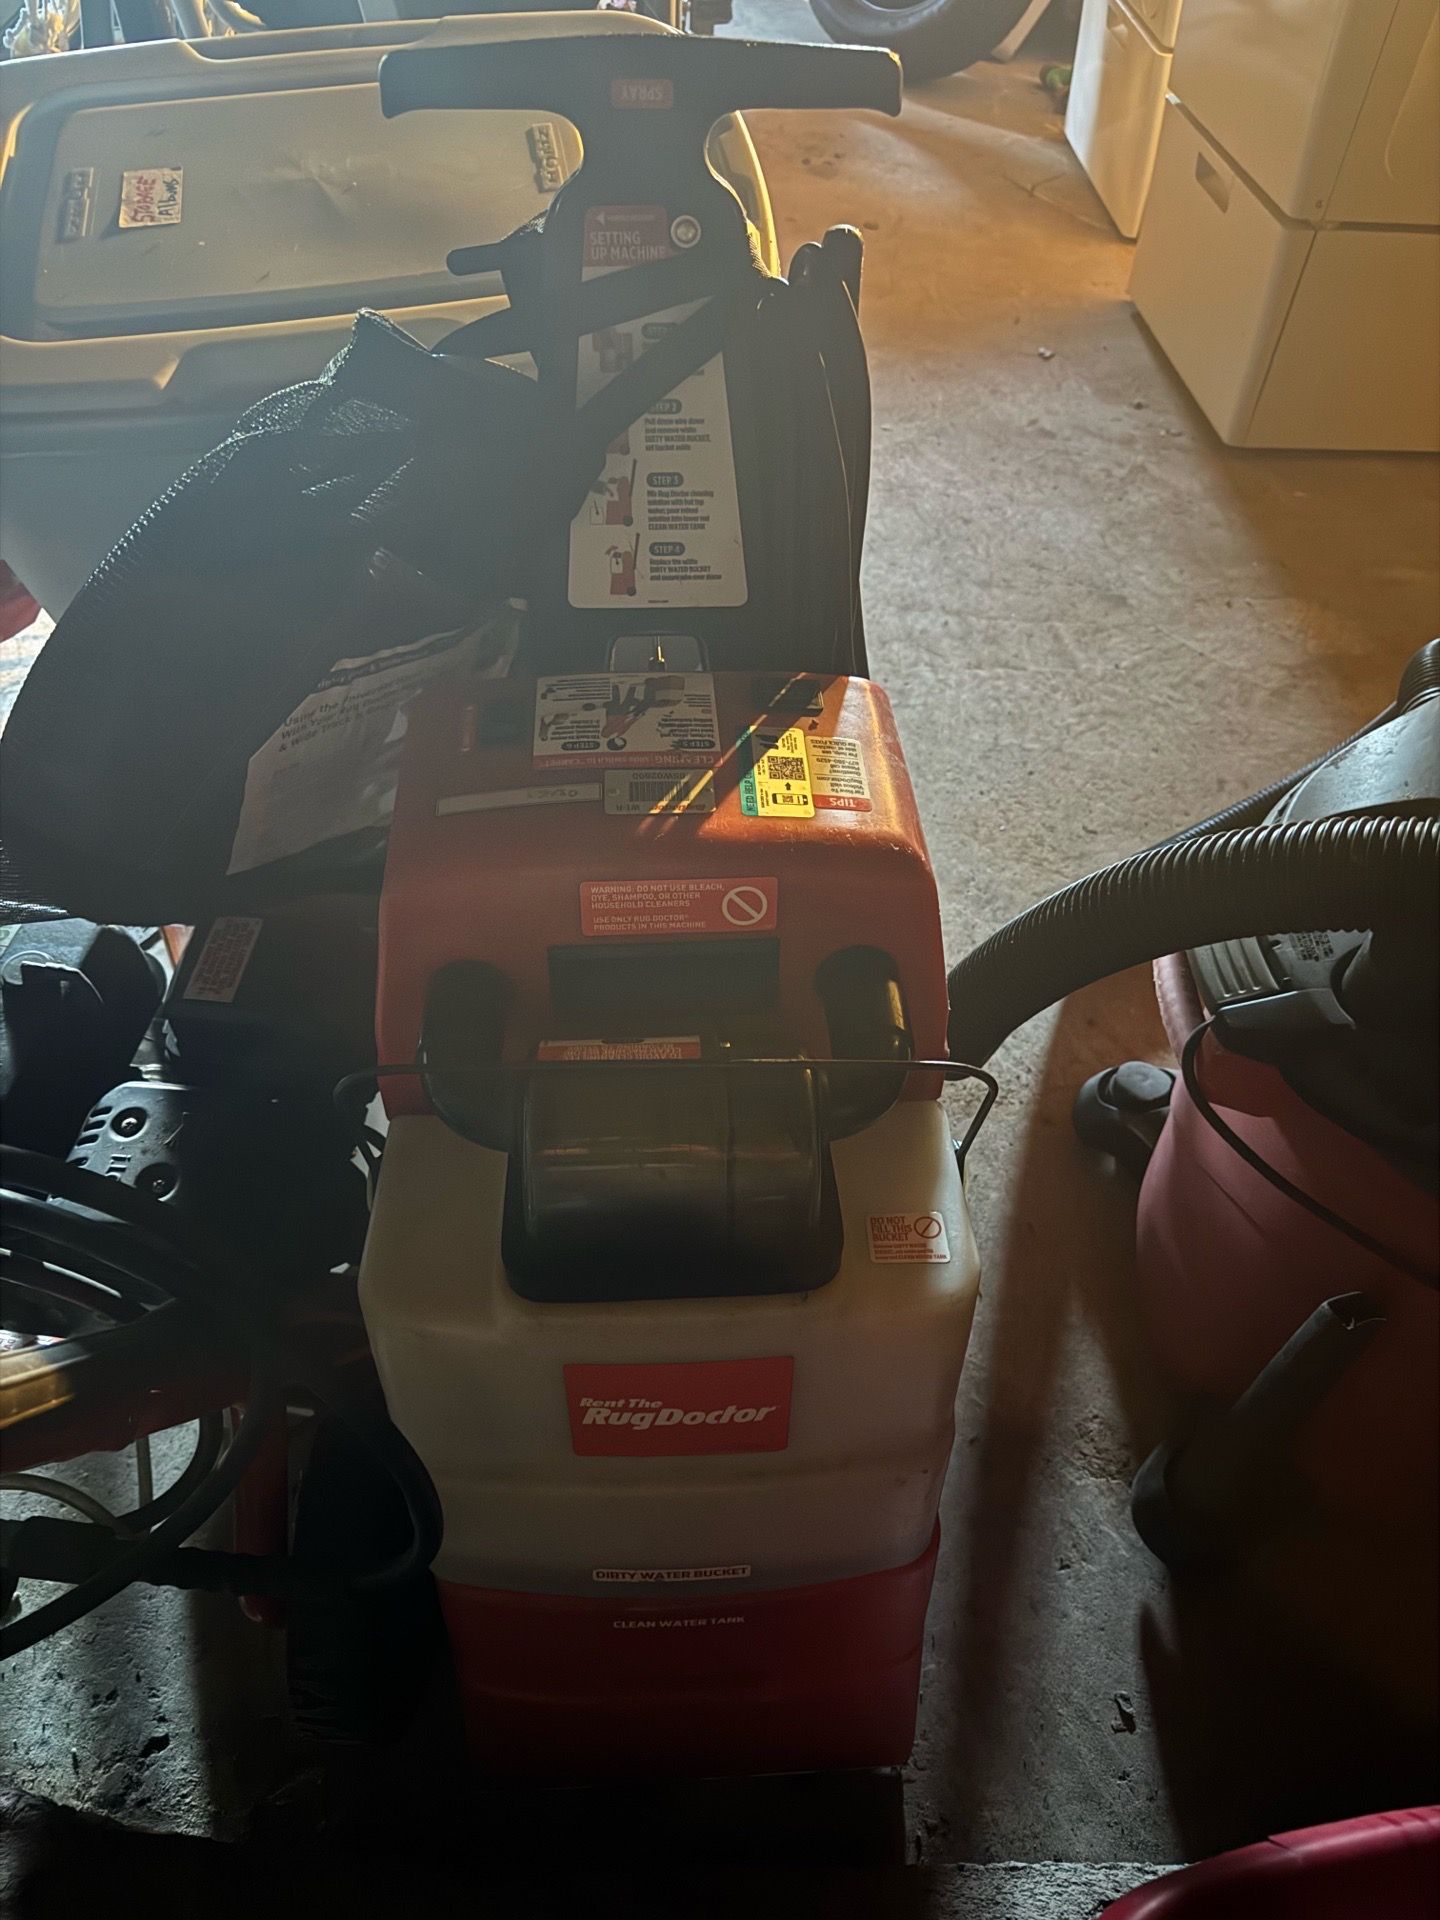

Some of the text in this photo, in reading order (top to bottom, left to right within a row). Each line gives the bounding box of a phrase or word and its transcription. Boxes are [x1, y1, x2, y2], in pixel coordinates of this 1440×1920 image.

[623, 86, 664, 100] SPRAY
[590, 231, 641, 246] SETTING
[591, 246, 608, 261] UP
[651, 476, 672, 485] STEP
[654, 545, 673, 554] STEP
[743, 780, 753, 795] HELP
[746, 795, 756, 812] NEED
[829, 797, 856, 808] TIPS
[637, 885, 648, 893] DO
[650, 884, 667, 893] NOT
[669, 884, 686, 892] USE
[688, 883, 725, 892] BLEACH,
[591, 894, 611, 903] DYE,
[659, 892, 671, 900] OR
[672, 892, 701, 900] OTHER
[591, 900, 691, 910] HOUSEHOLD CLEANERS
[593, 916, 610, 924] USE
[611, 915, 632, 923] ONLY
[593, 923, 637, 931] PRODUCTS
[669, 921, 706, 929] MACHINE
[870, 1216, 905, 1225] DO NOT
[871, 1224, 913, 1233] FILL THIS
[872, 1232, 909, 1242] BUCKET
[580, 1397, 664, 1409] Rent The
[582, 1405, 777, 1431] RugDoctor
[596, 1567, 748, 1580] DIRTY WATER BUCKET
[612, 1616, 745, 1629] CLEAN WATER TANK
